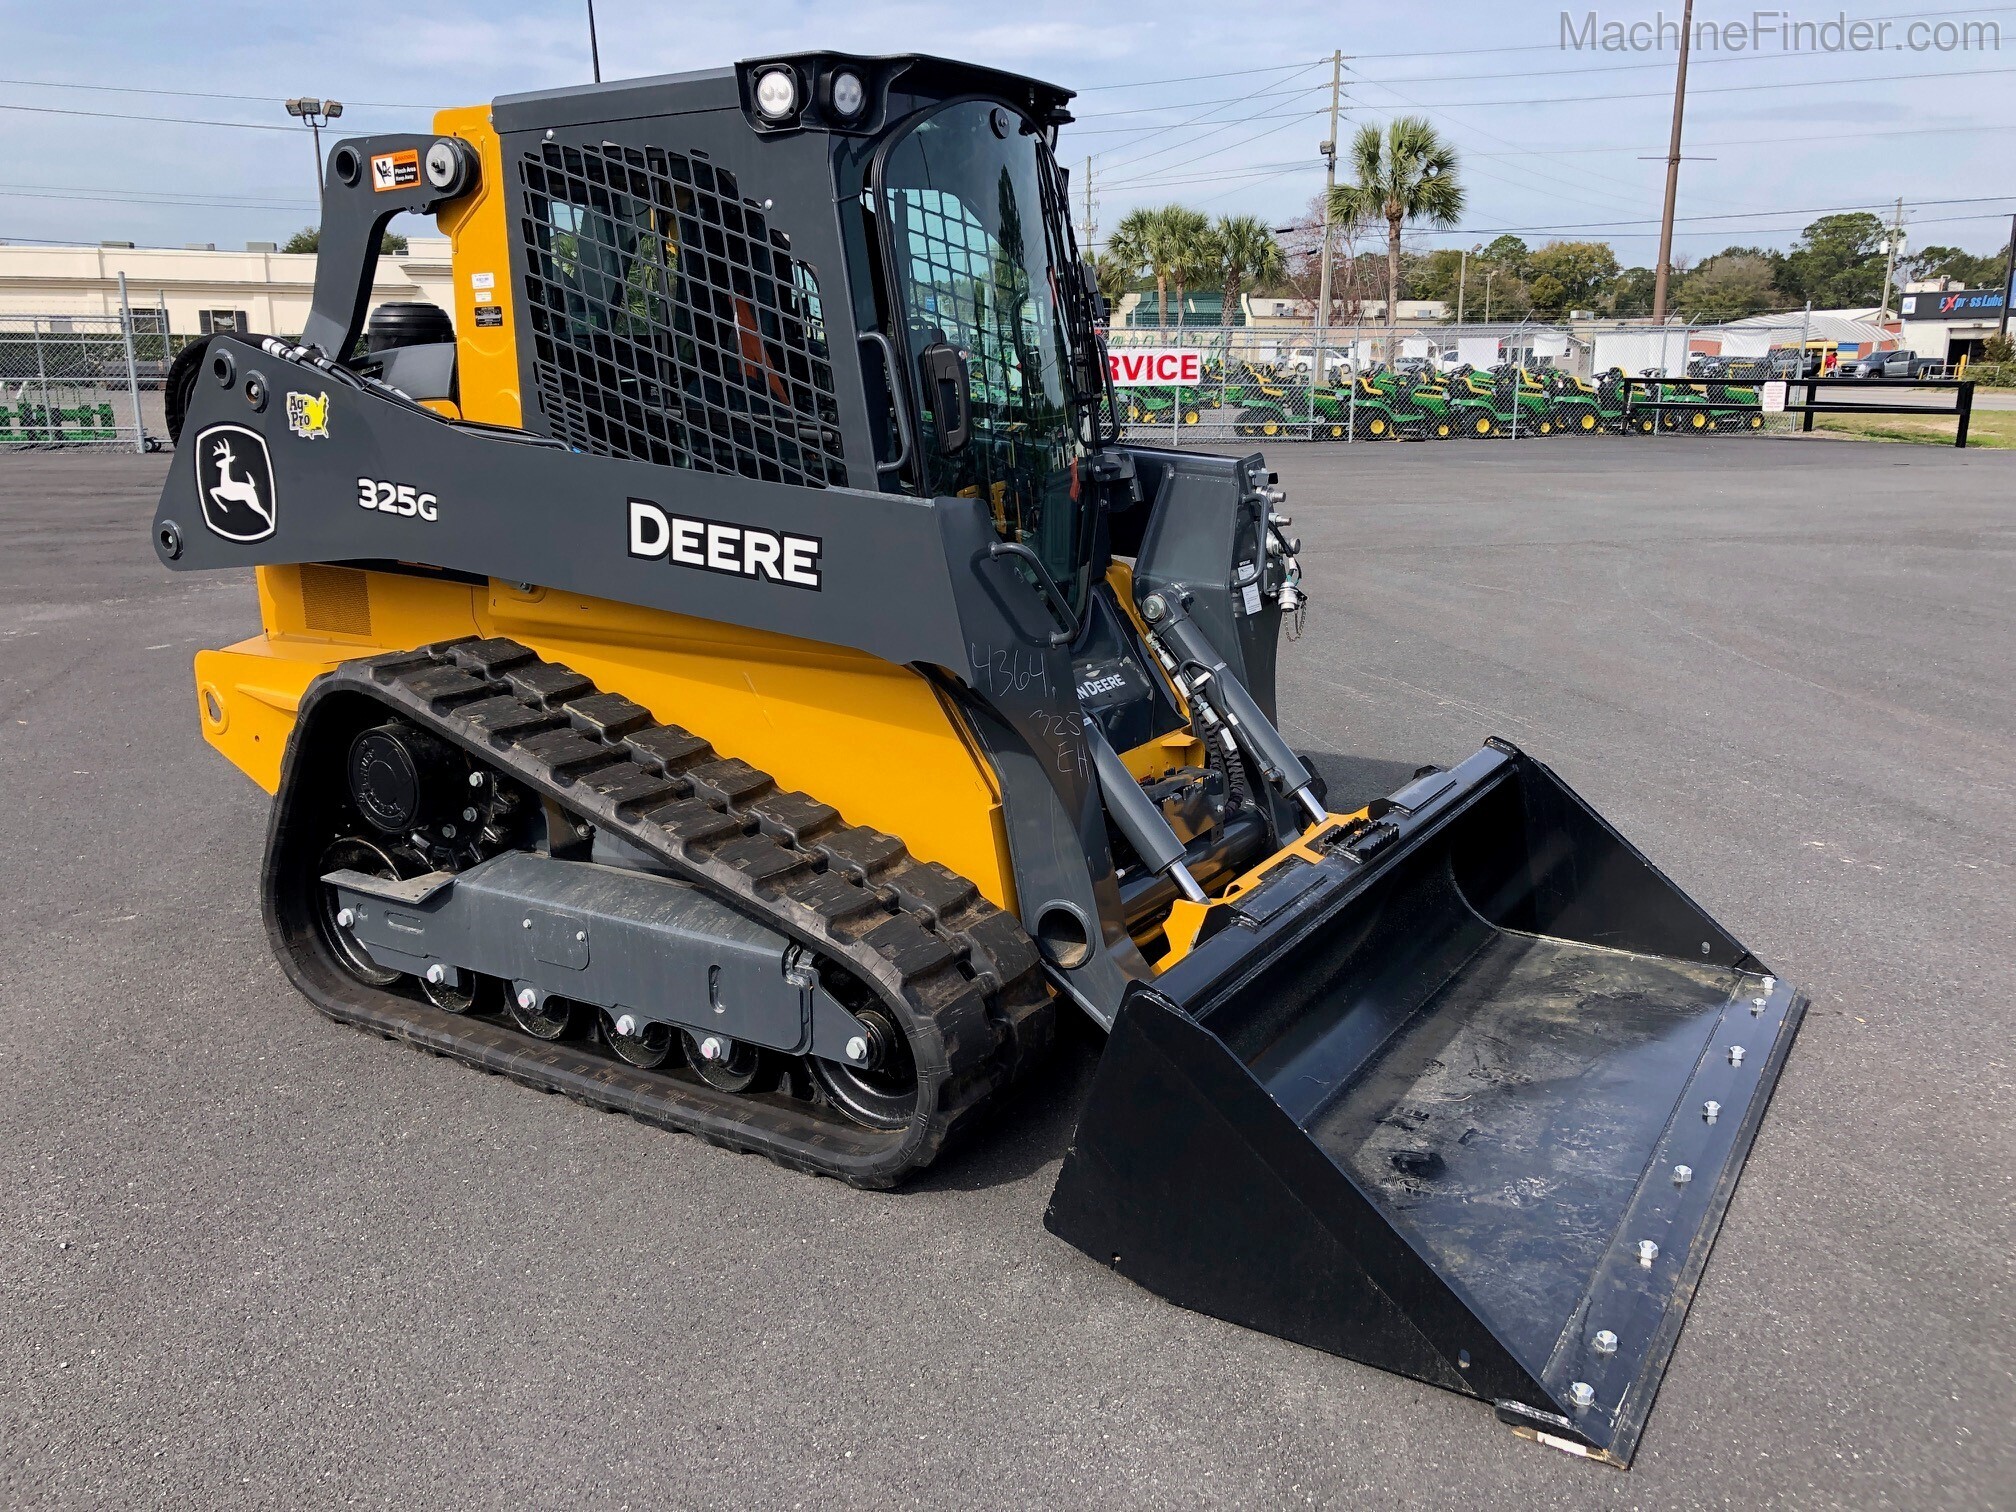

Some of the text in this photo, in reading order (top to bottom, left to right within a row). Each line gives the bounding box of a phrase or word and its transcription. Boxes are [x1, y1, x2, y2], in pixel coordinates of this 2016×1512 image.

[1939, 293, 2003, 313] EXprss Lube
[1107, 355, 1198, 381] RVICE
[291, 411, 310, 427] Pro
[357, 477, 438, 522] 325G
[629, 501, 819, 587] DEERE
[1083, 673, 1126, 696] DEERE
[1028, 709, 1082, 737] 325
